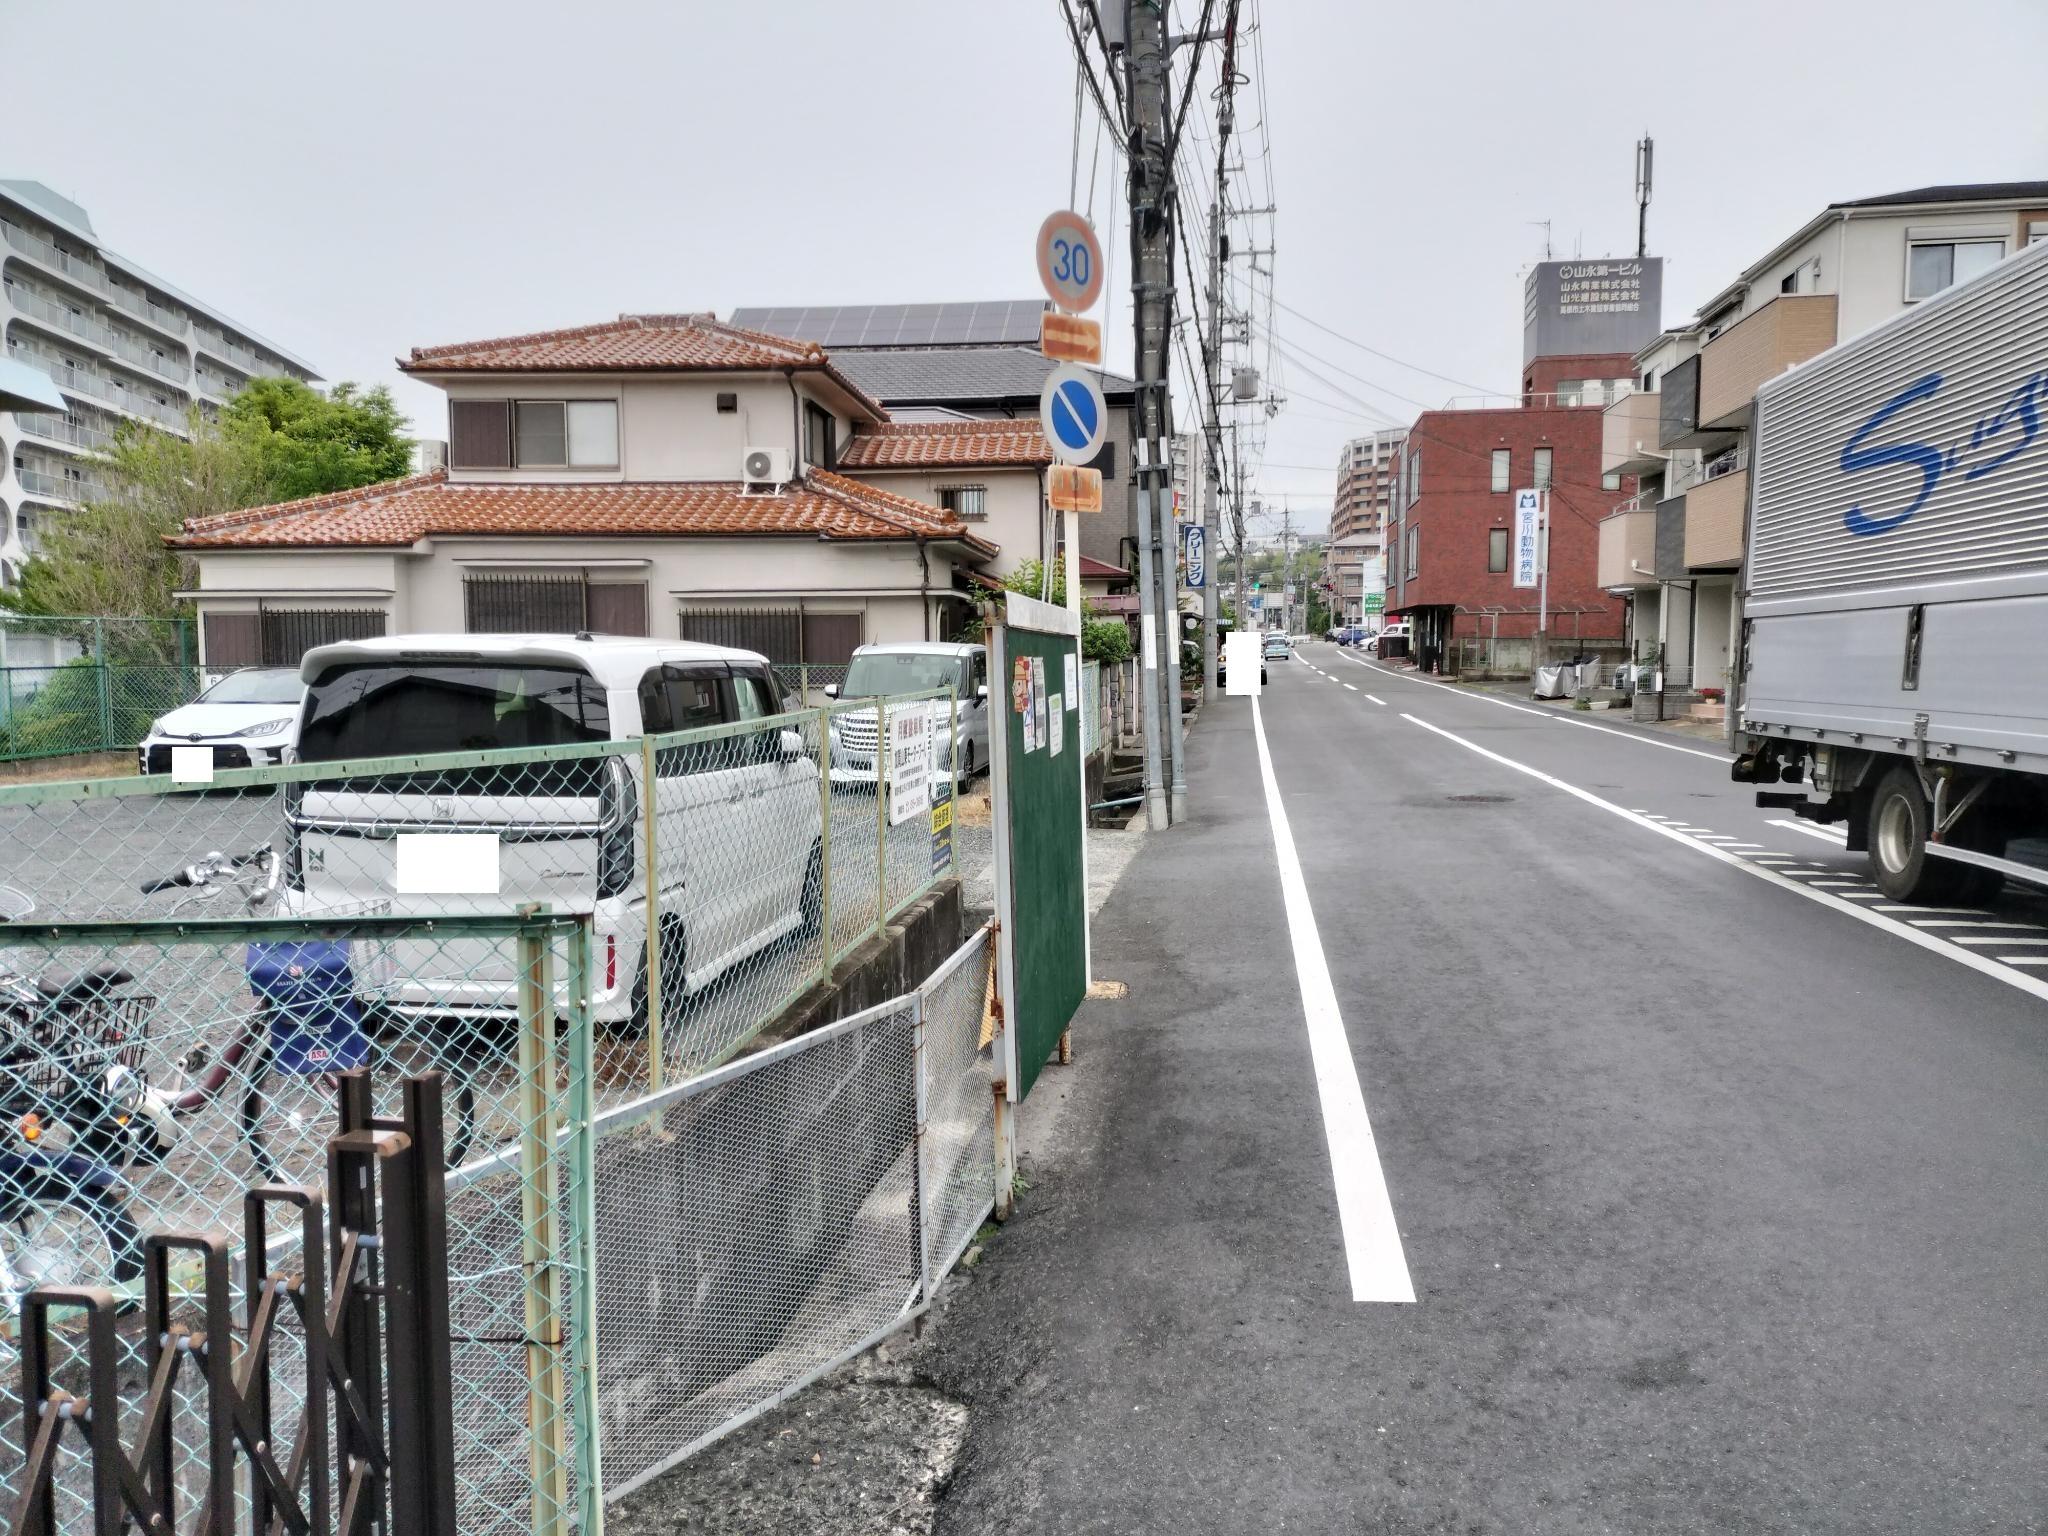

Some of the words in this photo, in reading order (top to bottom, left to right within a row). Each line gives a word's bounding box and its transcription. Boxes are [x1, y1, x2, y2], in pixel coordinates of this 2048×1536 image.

[1053, 239, 1090, 286] 30
[1190, 531, 1202, 580] クリーニング
[1520, 511, 1534, 583] 宮川動物病院
